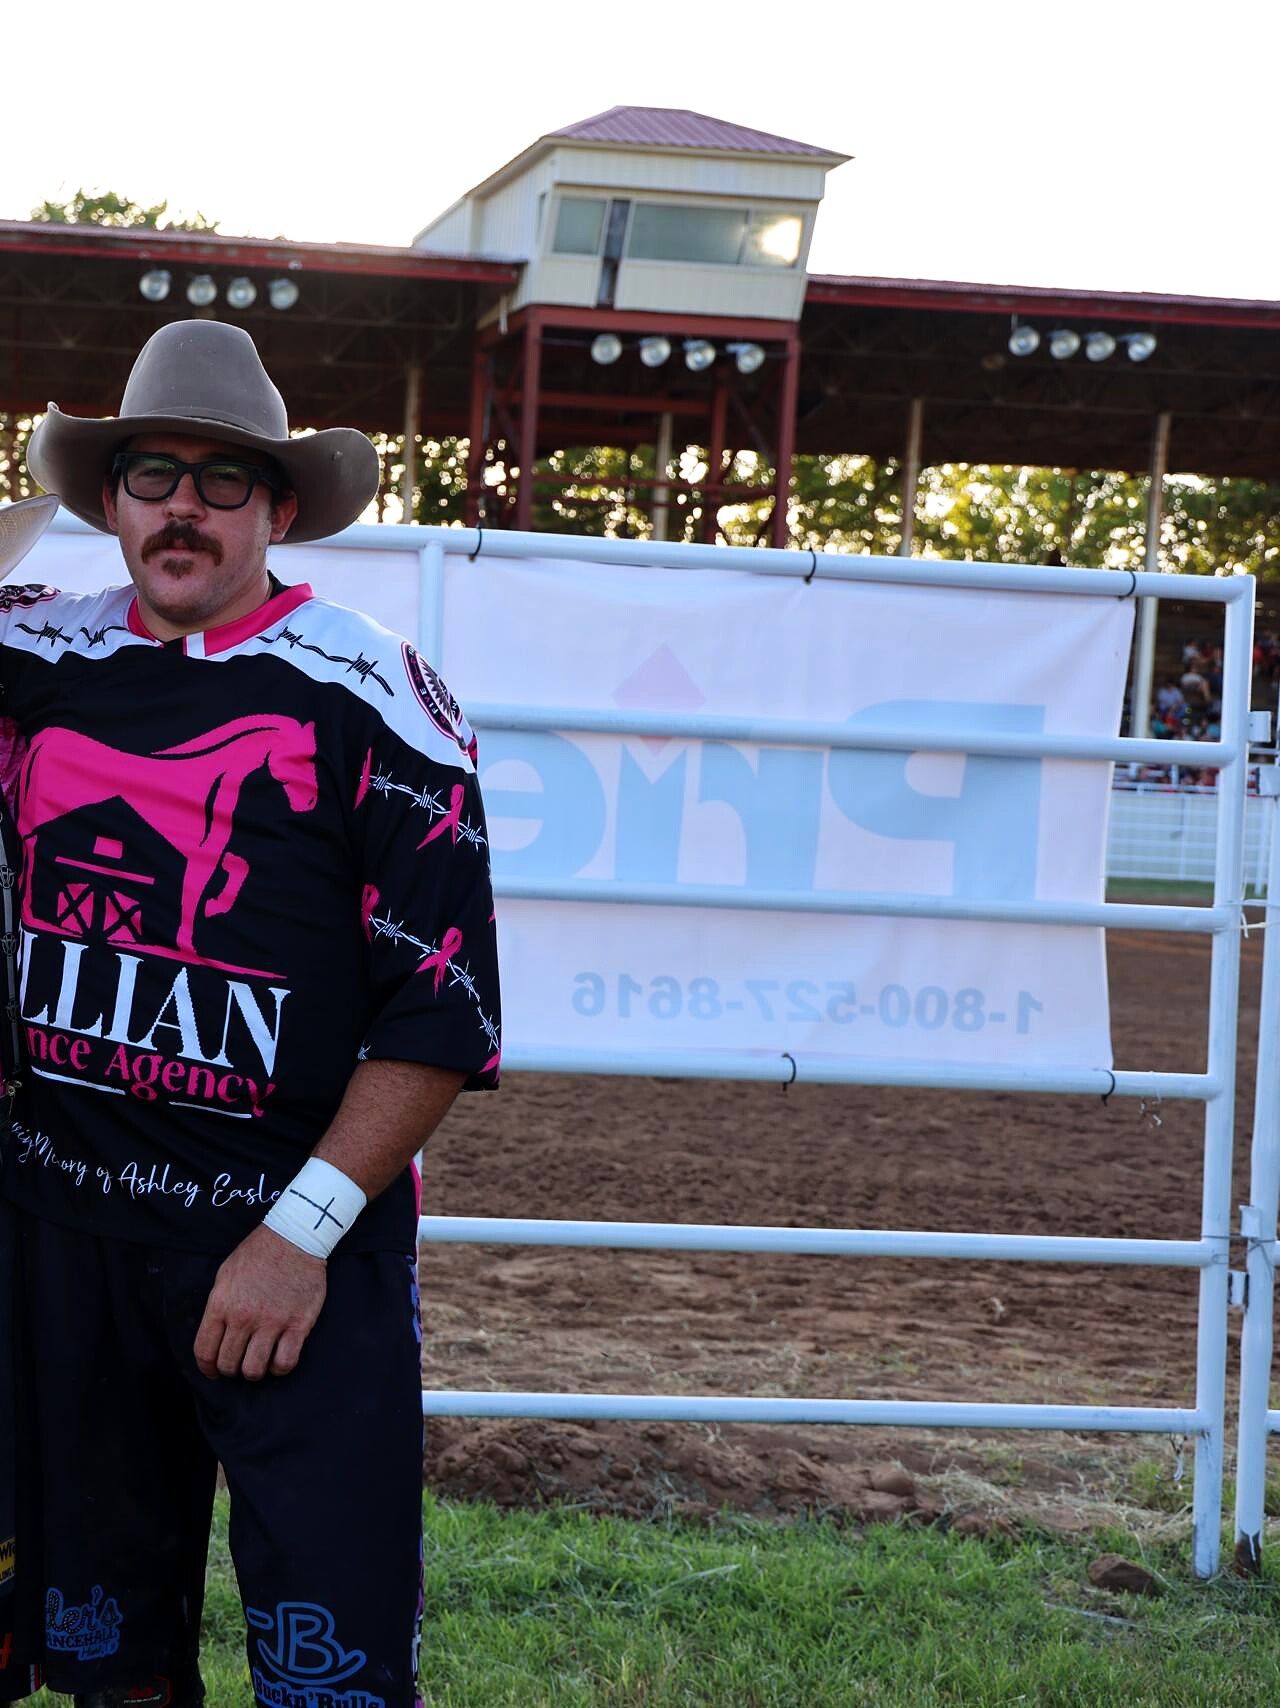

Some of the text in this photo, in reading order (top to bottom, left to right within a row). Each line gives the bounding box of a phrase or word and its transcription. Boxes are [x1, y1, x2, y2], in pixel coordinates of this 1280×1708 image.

[17, 931, 291, 1078] LLIAN
[26, 1027, 276, 1117] nce Agency
[117, 1161, 202, 1207] Ashley
[212, 1172, 282, 1207] Easle
